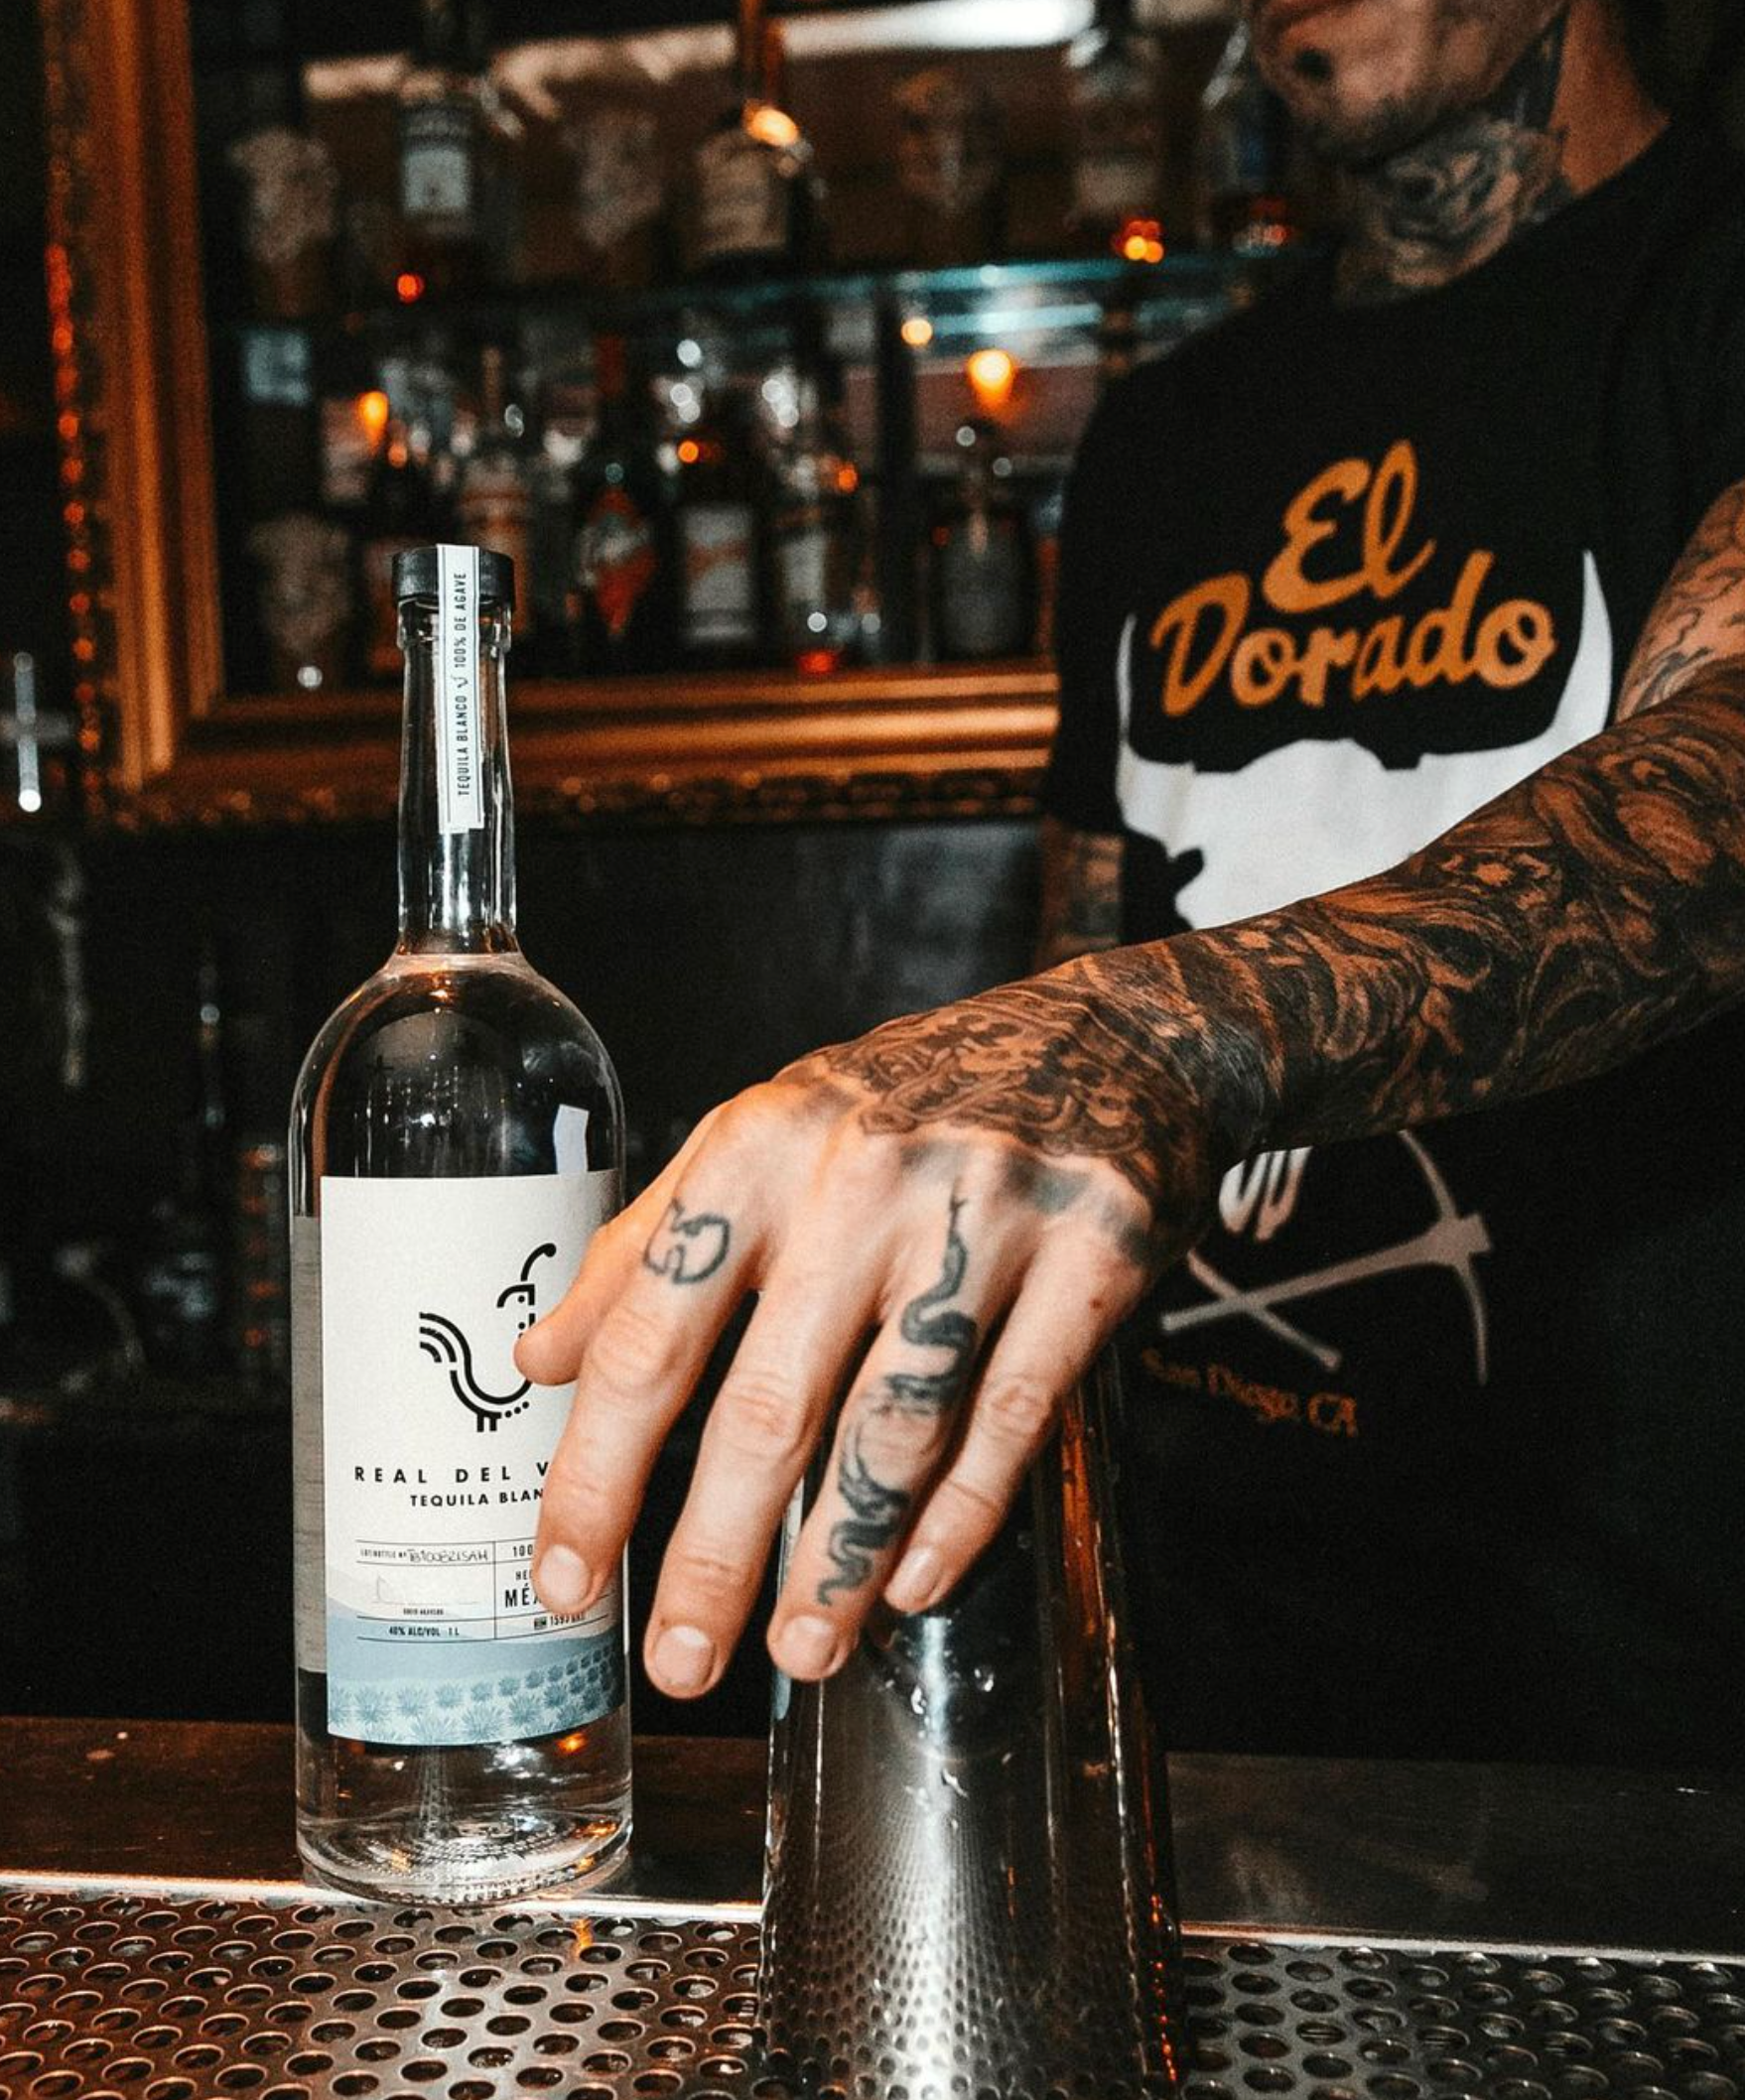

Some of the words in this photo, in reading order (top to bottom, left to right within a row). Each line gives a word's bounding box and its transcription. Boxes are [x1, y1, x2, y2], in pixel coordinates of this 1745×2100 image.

[1262, 439, 1436, 614] El
[454, 573, 467, 611] AGAVE
[454, 616, 467, 631] DE
[1149, 548, 1558, 717] Dorado
[454, 636, 467, 668] 100%
[455, 695, 469, 741] BLANCO
[457, 746, 470, 796] TEQUILA
[354, 1465, 427, 1484] REAL
[455, 1465, 511, 1484] DEL
[410, 1494, 489, 1508] TEQUILA
